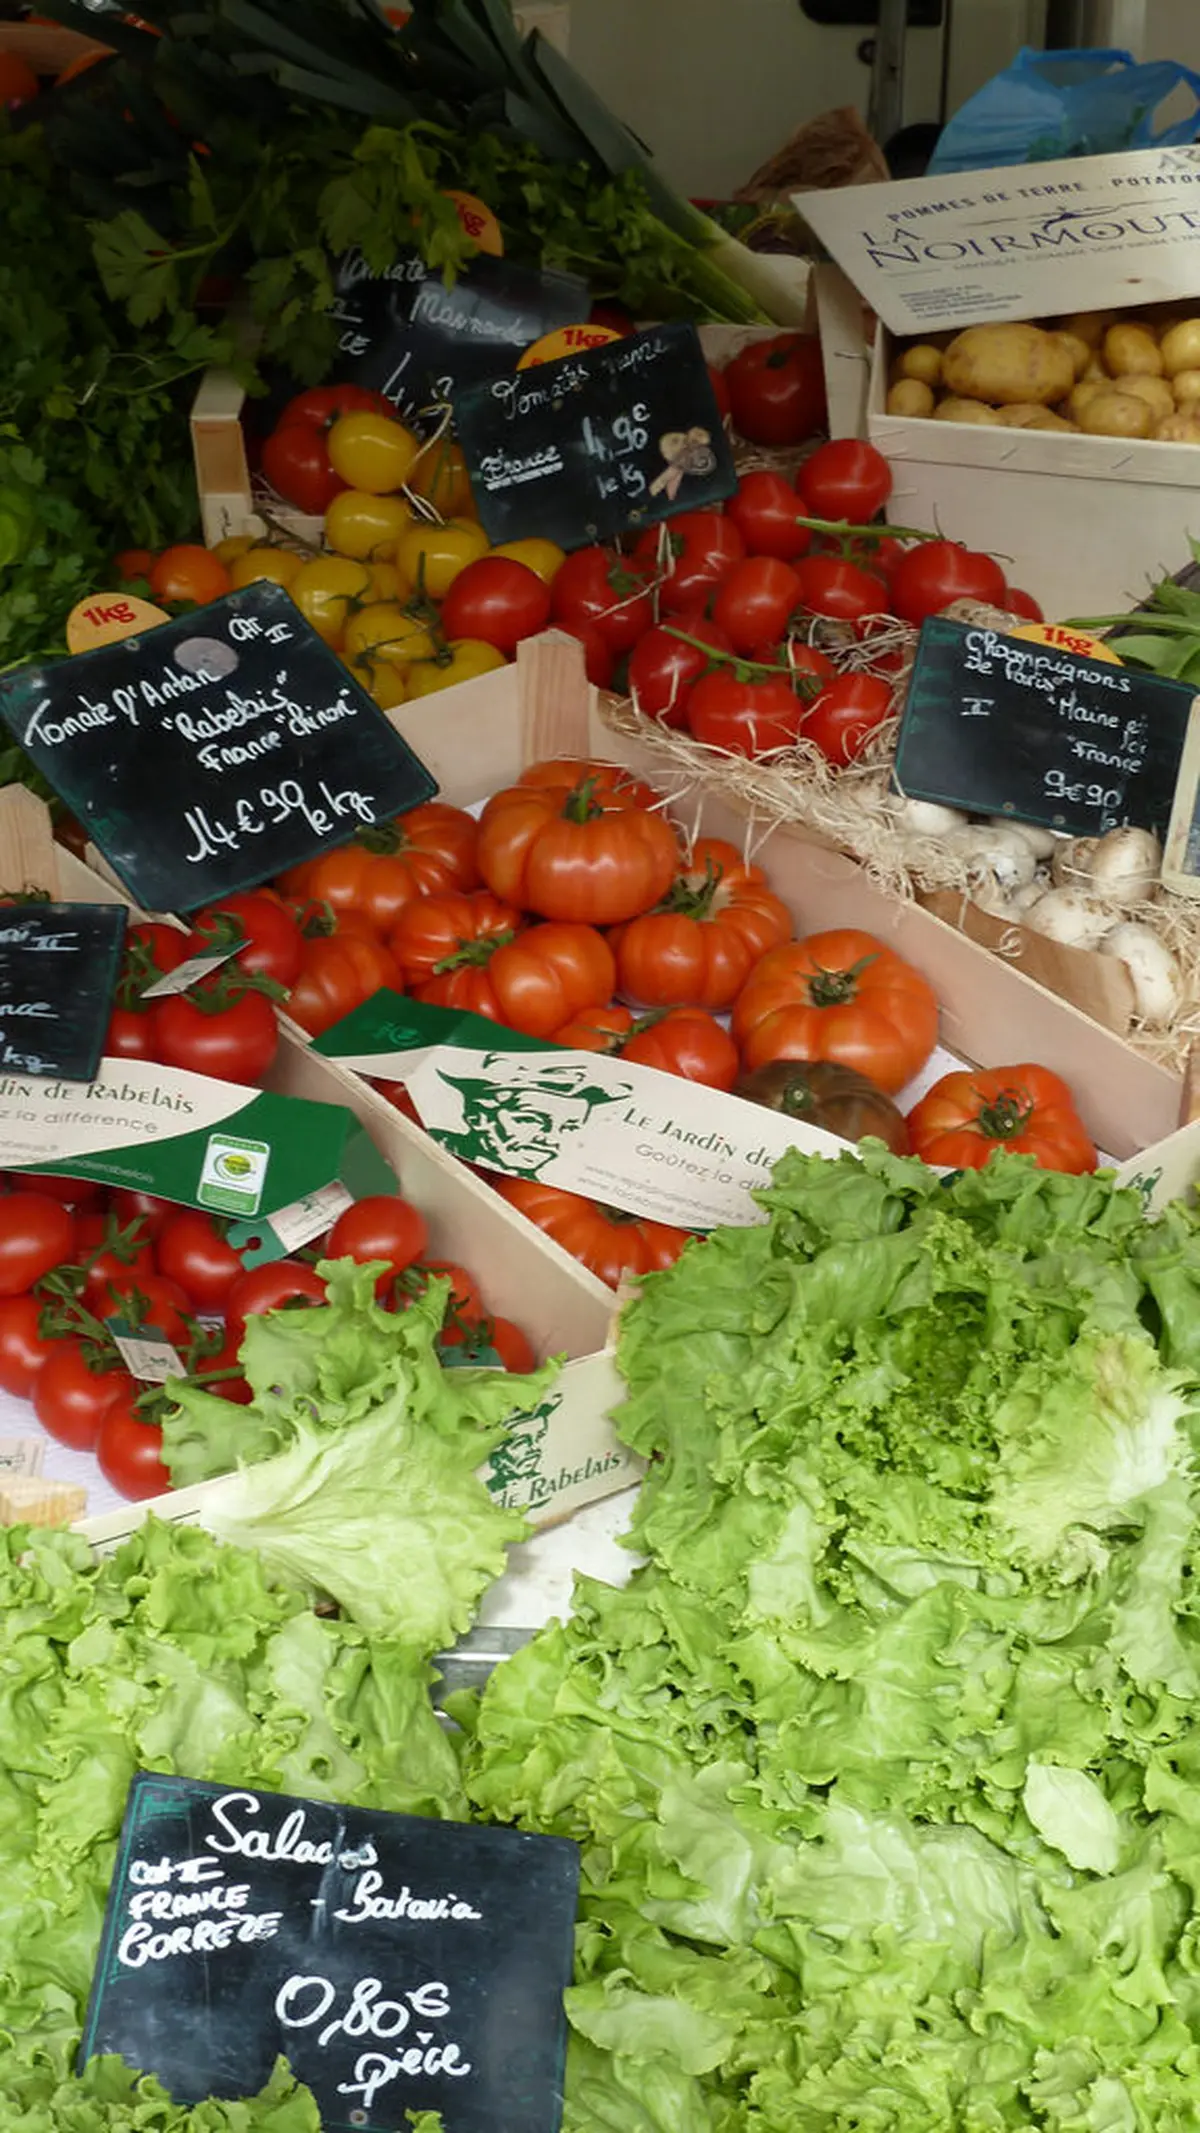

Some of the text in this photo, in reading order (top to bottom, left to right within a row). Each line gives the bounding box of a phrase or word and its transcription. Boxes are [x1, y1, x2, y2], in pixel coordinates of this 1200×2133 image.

[886, 197, 976, 224] POMMES
[982, 189, 1014, 203] DE
[1017, 180, 1085, 200] TERRE
[860, 226, 925, 247] LA
[81, 602, 137, 627] 1kg
[264, 622, 294, 645] II
[964, 631, 1132, 693] Champignons
[24, 695, 117, 747] Tomate
[197, 727, 283, 773] France
[86, 1083, 194, 1114] Rabelais
[657, 1120, 738, 1158] Jardin
[529, 1451, 621, 1502] Rabelais
[127, 1884, 251, 1920] FRANCE
[334, 1870, 484, 1923] Batavia
[275, 1974, 452, 2047] 0,80€
